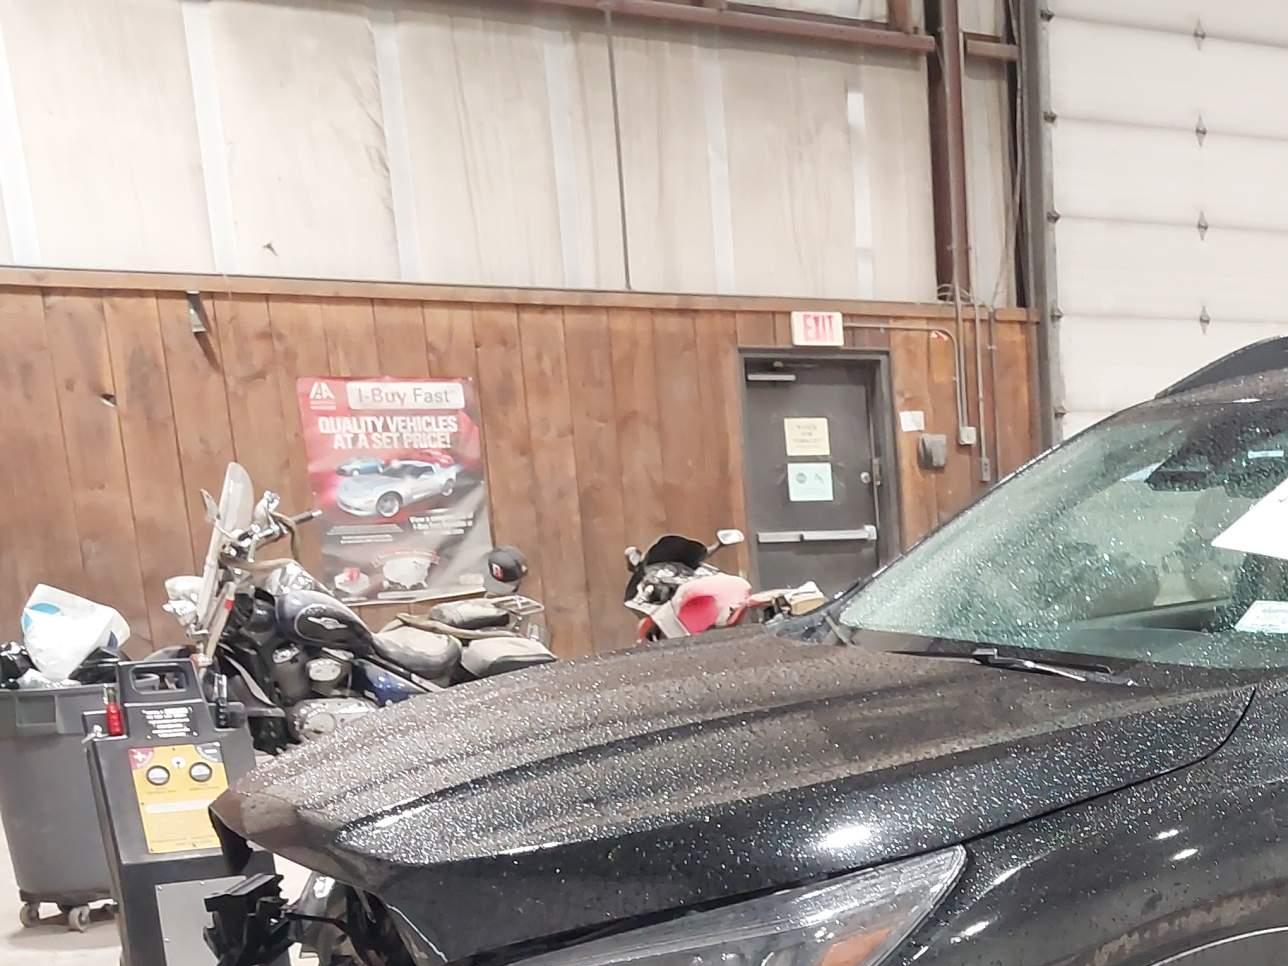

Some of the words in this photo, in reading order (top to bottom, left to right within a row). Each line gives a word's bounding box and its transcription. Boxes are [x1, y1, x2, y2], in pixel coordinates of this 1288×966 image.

[802, 314, 834, 342] EXIT
[357, 387, 406, 404] I-Buy
[413, 387, 450, 403] Fast
[318, 415, 385, 434] QUALITY
[386, 415, 459, 433] VEHICLES
[333, 433, 356, 449] AT
[357, 433, 370, 449] A
[371, 433, 401, 449] SET
[402, 432, 452, 449] PRICE!
